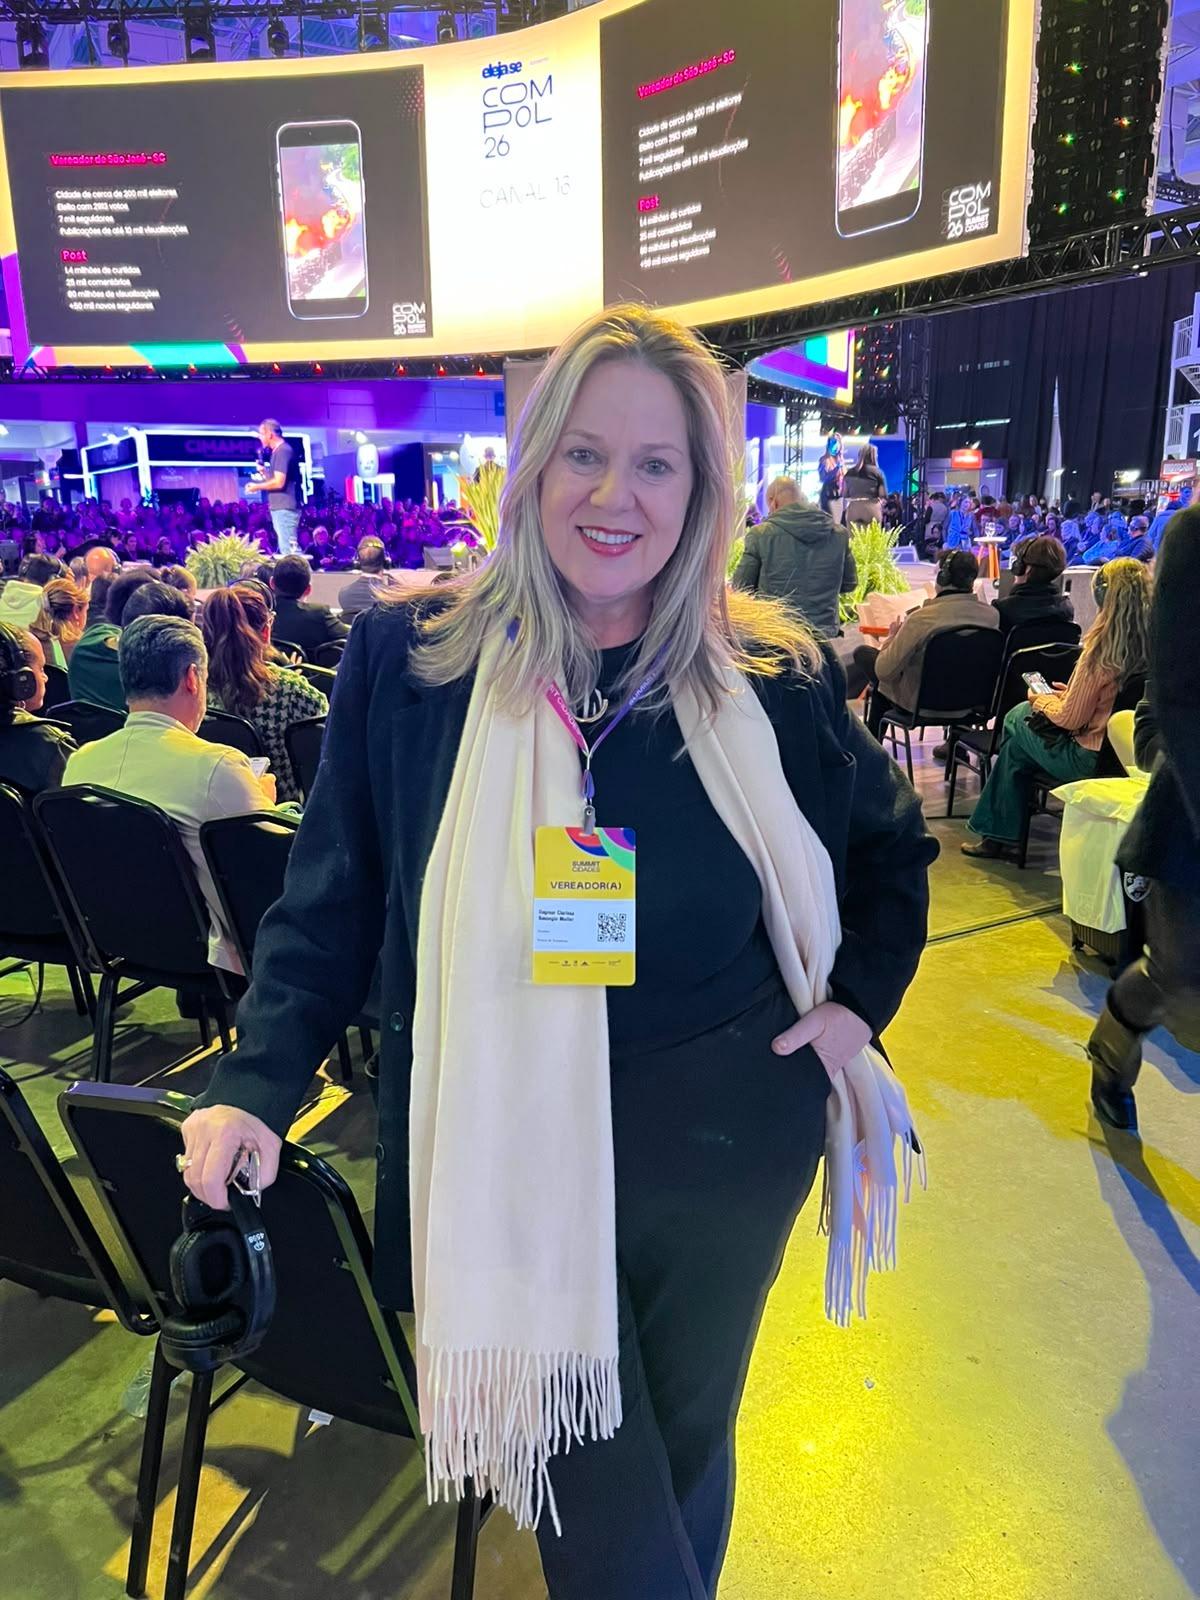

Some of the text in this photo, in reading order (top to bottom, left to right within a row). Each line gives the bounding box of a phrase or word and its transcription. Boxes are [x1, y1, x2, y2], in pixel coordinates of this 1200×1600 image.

[638, 78, 673, 98] Vereador
[683, 66, 699, 80] São
[699, 57, 717, 74] José
[723, 49, 735, 63] SC
[483, 75, 552, 108] COM
[483, 102, 552, 134] POL
[485, 134, 510, 158] 26
[654, 136, 668, 147] com
[51, 153, 93, 166] Vereador
[94, 154, 106, 165] de
[107, 153, 124, 164] São
[153, 152, 166, 163] SC
[55, 189, 81, 199] Cidade
[81, 189, 92, 199] de
[92, 190, 113, 199] cerca
[113, 189, 123, 199] de
[137, 188, 148, 198] mil
[949, 180, 991, 206] COM
[76, 203, 92, 211] com
[639, 195, 659, 211] Post
[948, 199, 989, 222] POL
[63, 215, 75, 223] mil
[133, 225, 144, 235] mil
[947, 220, 963, 240] 26
[62, 250, 87, 261] Post
[551, 881, 622, 891] VEREADOR(A)
